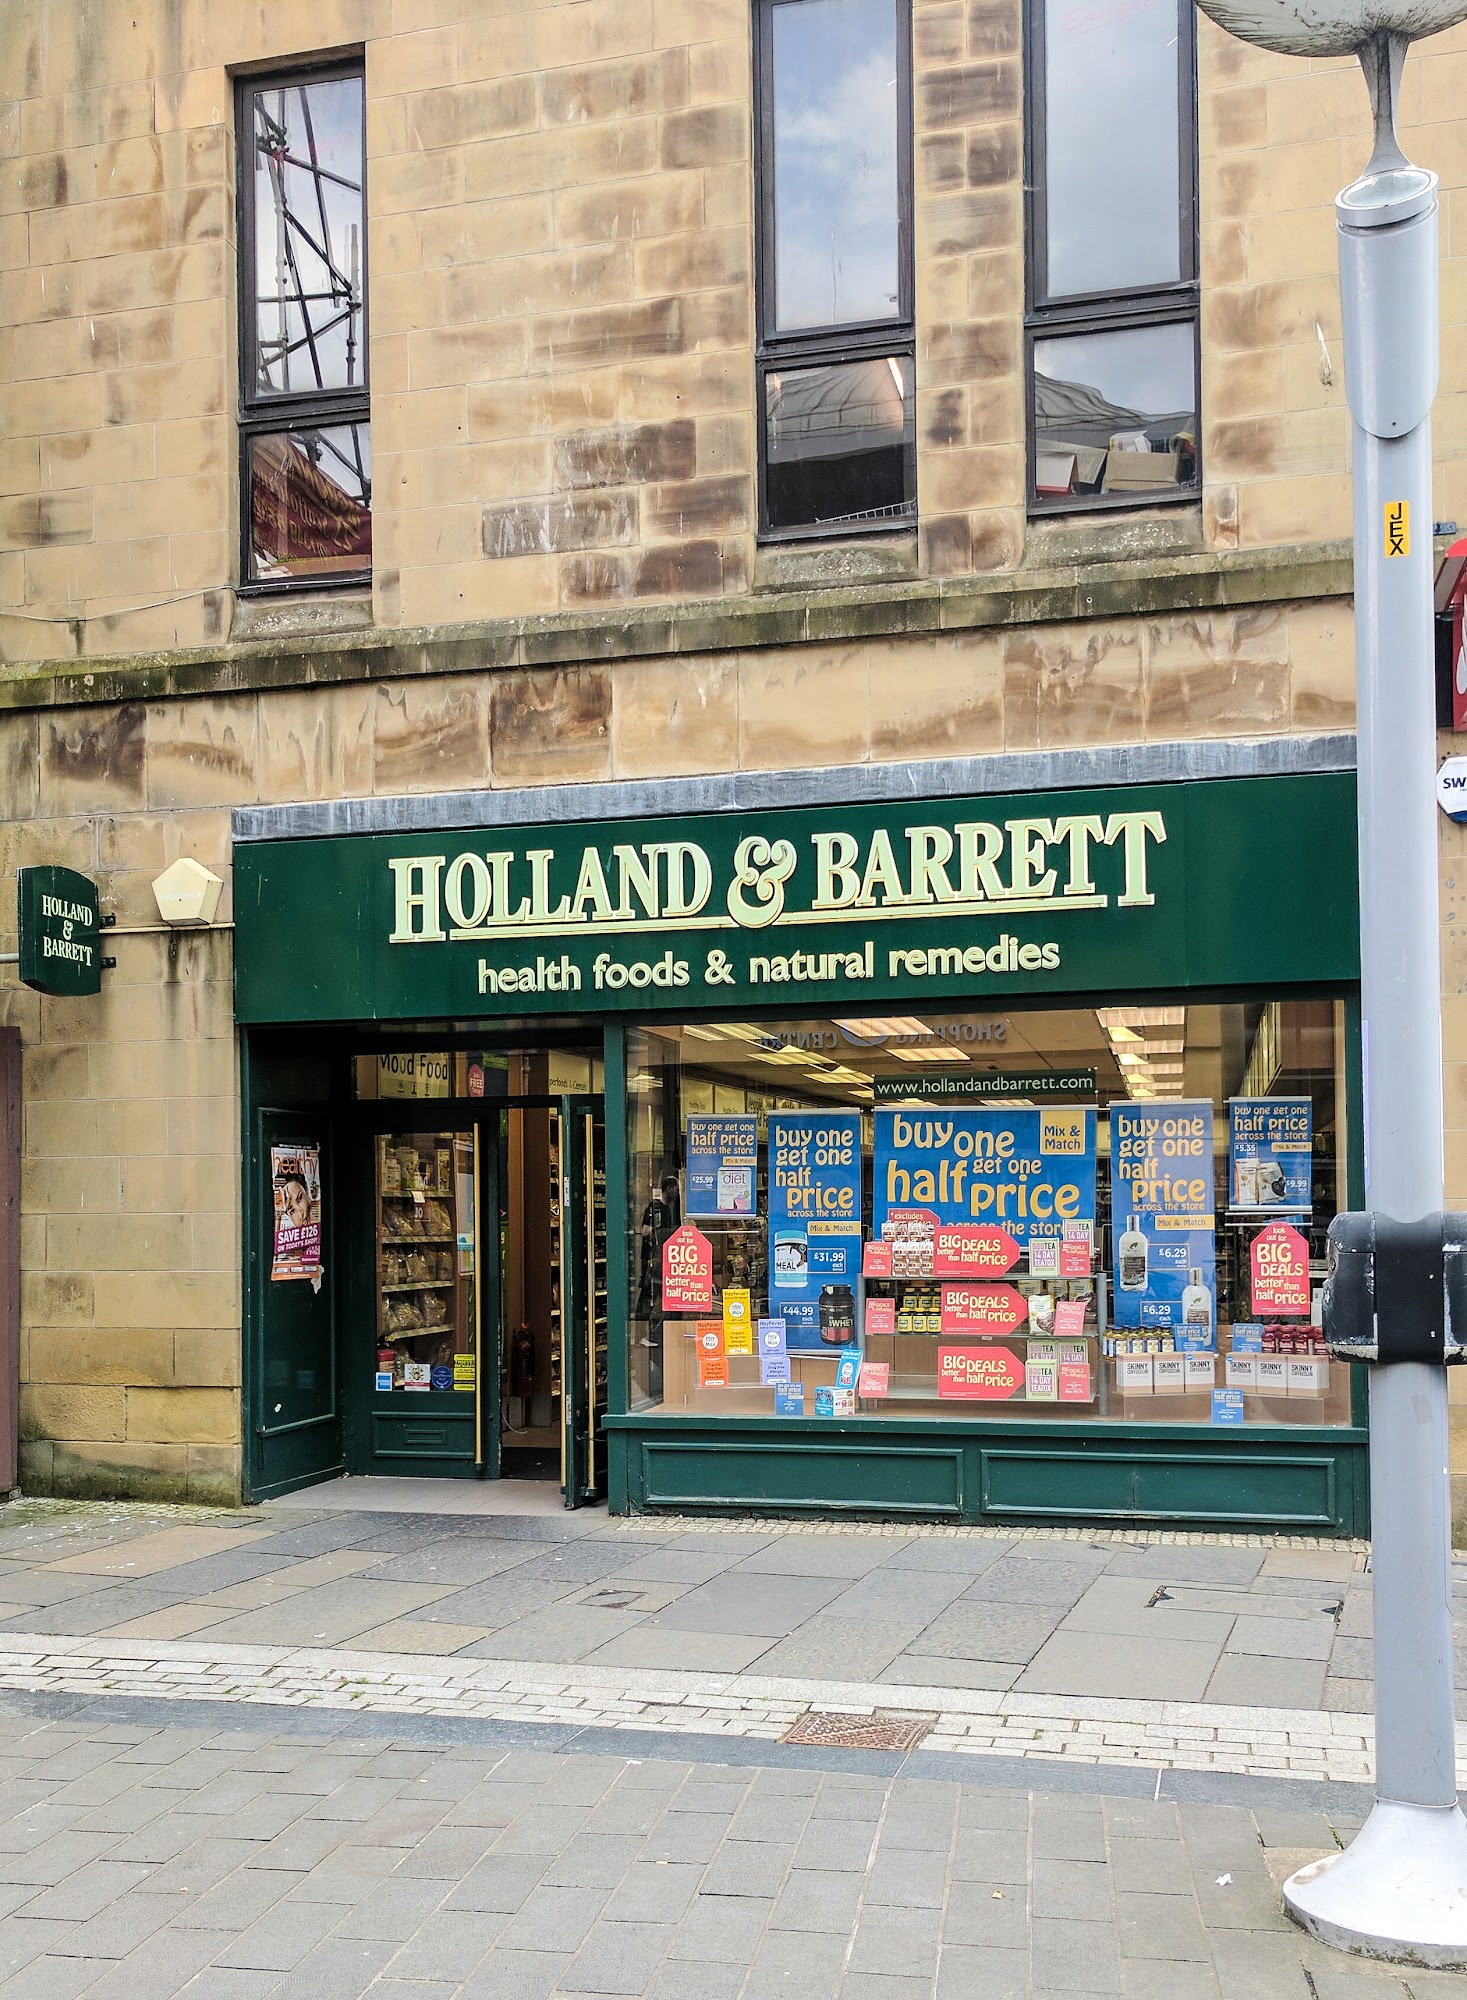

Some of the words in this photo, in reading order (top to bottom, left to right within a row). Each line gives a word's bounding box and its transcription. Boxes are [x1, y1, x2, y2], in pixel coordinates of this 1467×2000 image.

[1389, 502, 1405, 556] JEX
[389, 841, 712, 944] HOLLAND
[727, 835, 797, 929] &
[811, 810, 1168, 909] BARRETT
[42, 895, 93, 927] HOLLAND
[63, 920, 73, 940] &
[43, 936, 92, 966] BARRETT
[478, 956, 581, 994] health
[593, 951, 690, 989] foods
[704, 950, 736, 984] &
[749, 940, 874, 983] natural
[889, 934, 1061, 977] remedies
[877, 1076, 1093, 1094] www.hollandandbarrett.com
[1234, 1105, 1251, 1115] buy
[1253, 1106, 1270, 1115] one
[1273, 1105, 1288, 1115] get
[1290, 1106, 1307, 1115] one
[691, 1122, 706, 1131] buy
[708, 1123, 722, 1131] one
[724, 1123, 738, 1132] get
[740, 1123, 754, 1131] one
[1118, 1114, 1159, 1137] buy
[1162, 1118, 1204, 1137] one
[1234, 1115, 1264, 1131] half
[1268, 1115, 1308, 1130] price
[775, 1125, 812, 1147] buy
[815, 1129, 853, 1146] one
[893, 1114, 953, 1148] buy
[954, 1131, 1015, 1157] one
[1044, 1125, 1065, 1136] Mix
[1069, 1125, 1081, 1136] &
[1234, 1132, 1264, 1140] across
[1267, 1131, 1281, 1140] the
[1284, 1131, 1307, 1140] store
[691, 1132, 717, 1145] half
[720, 1132, 754, 1145] price
[1044, 1138, 1081, 1150] Match
[719, 1146, 732, 1154] the
[1118, 1137, 1155, 1157] get
[1162, 1138, 1203, 1157] one
[776, 1147, 808, 1166] get
[815, 1148, 852, 1165] one
[972, 1158, 1001, 1174] get
[1007, 1159, 1042, 1174] one
[1119, 1158, 1158, 1179] half
[692, 1176, 713, 1184] £25.99
[723, 1173, 746, 1184] diet
[775, 1167, 811, 1186] half
[887, 1160, 968, 1203] half
[970, 1173, 1080, 1218] price
[1132, 1173, 1205, 1202] price
[1286, 1180, 1307, 1188] £9.99
[787, 1181, 854, 1209] price
[816, 1208, 829, 1217] the
[831, 1209, 853, 1217] store
[1133, 1203, 1162, 1211] across
[1165, 1202, 1178, 1210] the
[1181, 1202, 1205, 1210] store
[278, 1229, 300, 1245] SAVE
[301, 1224, 318, 1240] £126
[1029, 1221, 1063, 1235] stor
[1076, 1231, 1088, 1239] DAY
[939, 1235, 961, 1248] BIG
[962, 1239, 1001, 1252] DEALS
[668, 1245, 698, 1263] BIG
[814, 1252, 844, 1262] £31.99
[961, 1252, 980, 1262] half
[980, 1253, 1008, 1265] price
[1159, 1248, 1186, 1258] £6.29
[1256, 1242, 1291, 1263] BIG
[1034, 1258, 1055, 1266] TEATOX
[670, 1264, 708, 1276] DEALS
[1260, 1263, 1304, 1276] DEALS
[665, 1276, 690, 1286] better
[690, 1281, 703, 1289] than
[1254, 1277, 1284, 1288] better
[1284, 1282, 1299, 1290] than
[666, 1288, 682, 1297] half
[681, 1289, 709, 1301] price
[947, 1291, 969, 1304] BIG
[969, 1296, 1009, 1308] DEALS
[1255, 1289, 1274, 1300] half
[1274, 1291, 1307, 1304] price
[783, 1306, 813, 1315] £44.99
[969, 1308, 987, 1319] half
[988, 1309, 1016, 1322] price
[1143, 1305, 1170, 1315] £6.29
[943, 1355, 966, 1368] BIG
[966, 1360, 1006, 1372] DEALS
[1062, 1353, 1069, 1361] 14
[1071, 1353, 1083, 1361] DAY
[1189, 1360, 1211, 1368] SKINNY
[1291, 1364, 1313, 1372] SKINNY
[966, 1373, 984, 1383] half
[985, 1373, 1014, 1386] price
[1030, 1376, 1038, 1384] 14
[1039, 1376, 1051, 1384] DAY
[1031, 1384, 1051, 1392] TEATOX
